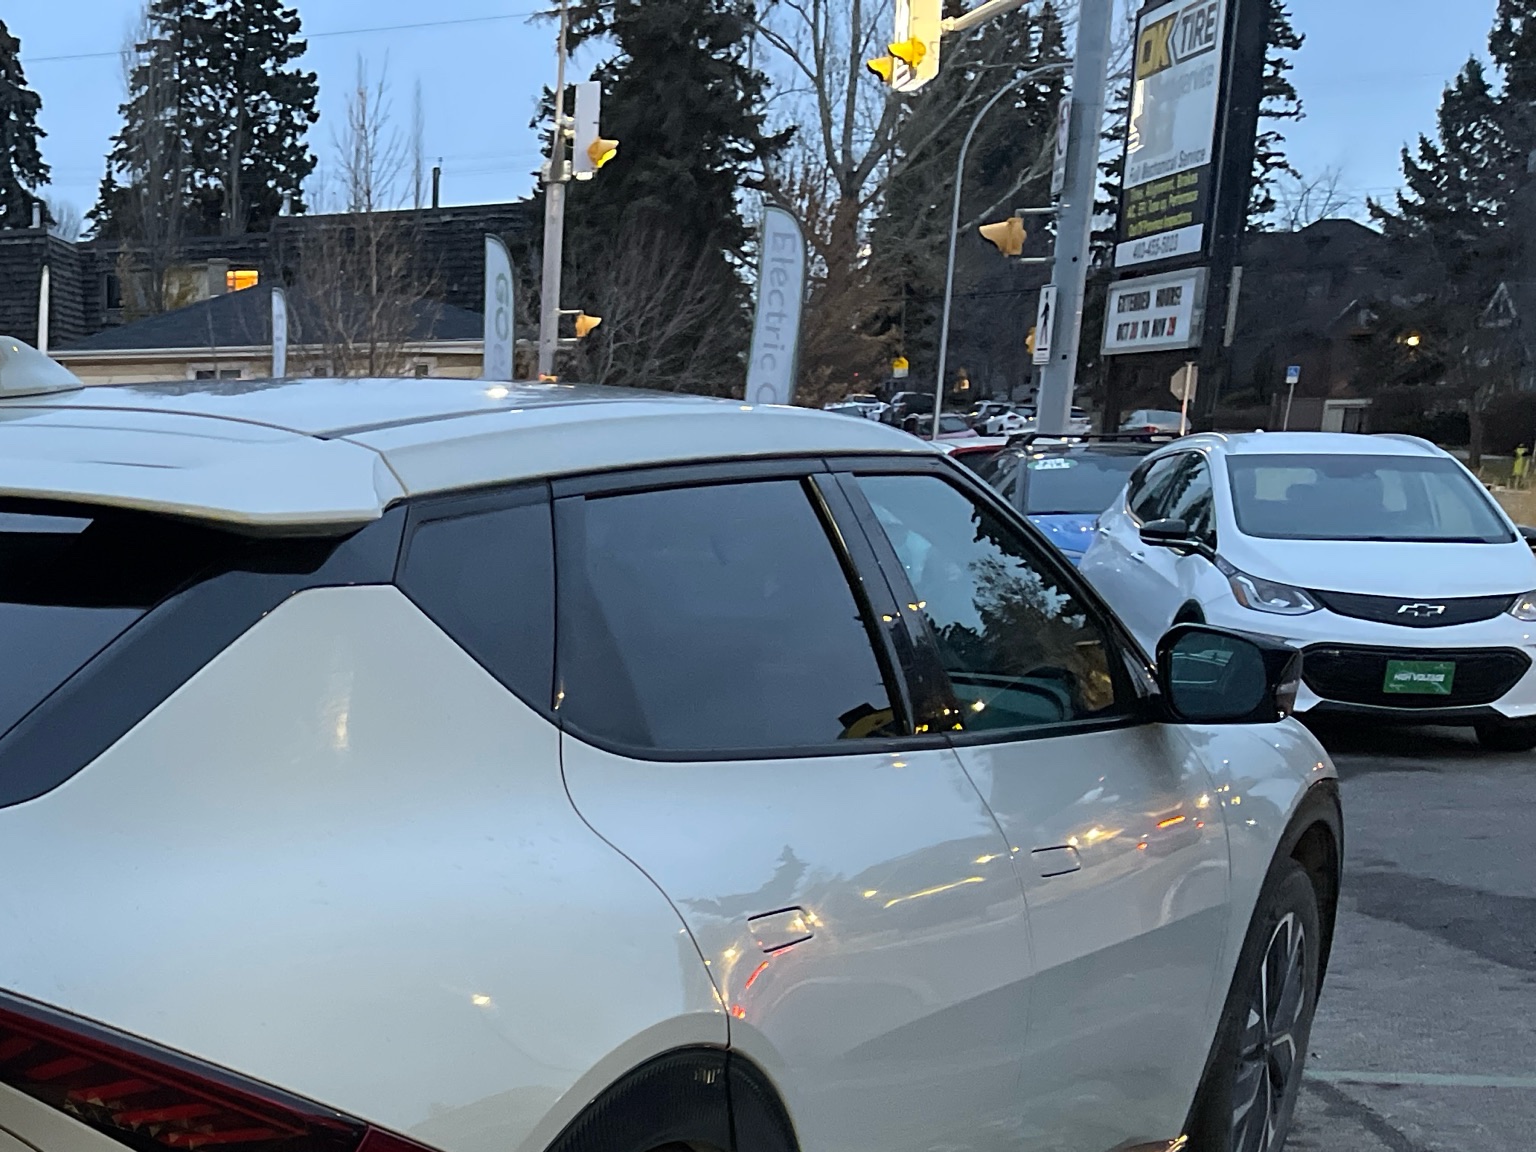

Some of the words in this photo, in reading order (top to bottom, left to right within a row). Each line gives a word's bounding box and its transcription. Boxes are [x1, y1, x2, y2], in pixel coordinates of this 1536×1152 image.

[1137, 14, 1176, 80] OK
[1181, 3, 1217, 54] TIRE
[761, 232, 796, 371] Electric
